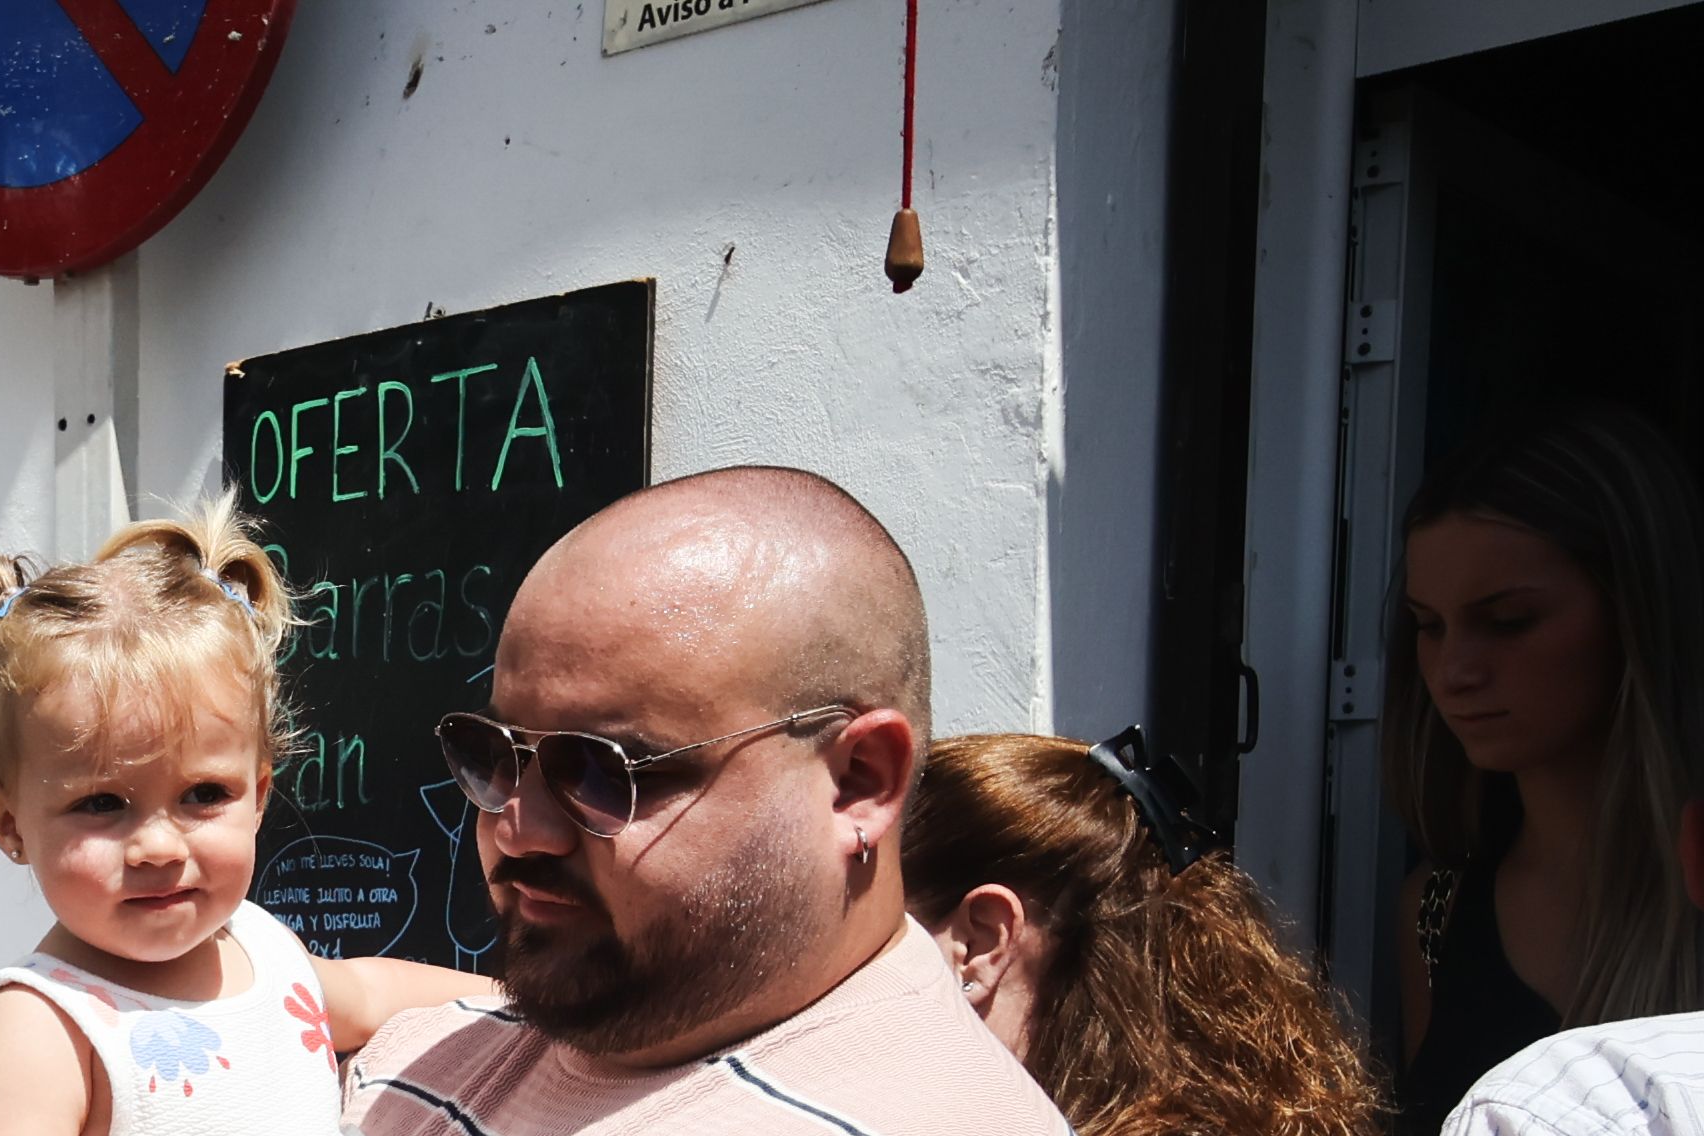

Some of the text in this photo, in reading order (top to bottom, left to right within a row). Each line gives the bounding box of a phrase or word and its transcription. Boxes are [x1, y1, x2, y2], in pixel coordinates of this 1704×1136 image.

[637, 0, 711, 32] Aviso
[250, 356, 564, 504] OFERTA
[357, 887, 365, 903] A
[369, 887, 398, 903] OTRA
[309, 914, 318, 932] Y
[323, 912, 382, 931] DISFRUTA
